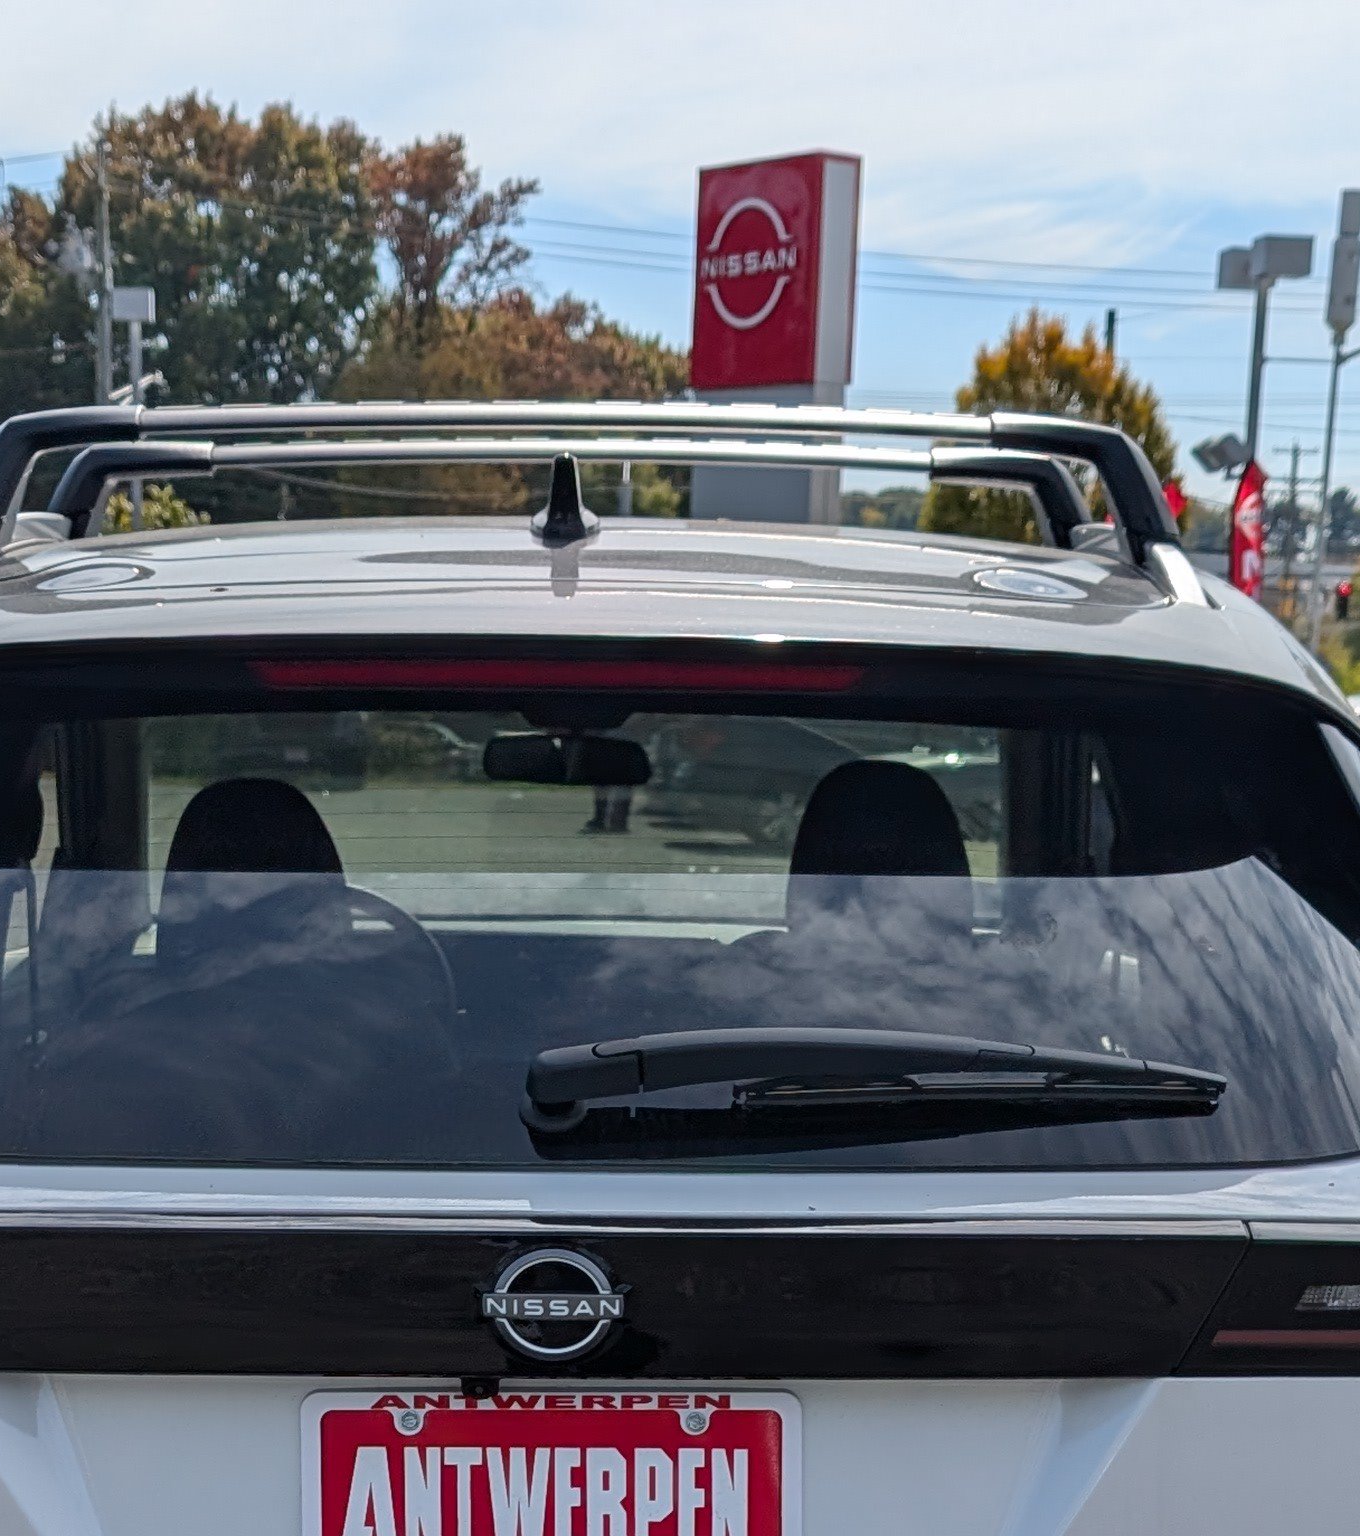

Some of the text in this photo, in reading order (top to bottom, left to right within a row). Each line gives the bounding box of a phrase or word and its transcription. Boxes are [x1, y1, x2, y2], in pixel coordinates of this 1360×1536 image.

[701, 246, 798, 279] NISSAN
[486, 1298, 621, 1316] NISSAN
[371, 1394, 731, 1409] ANTWERPEN
